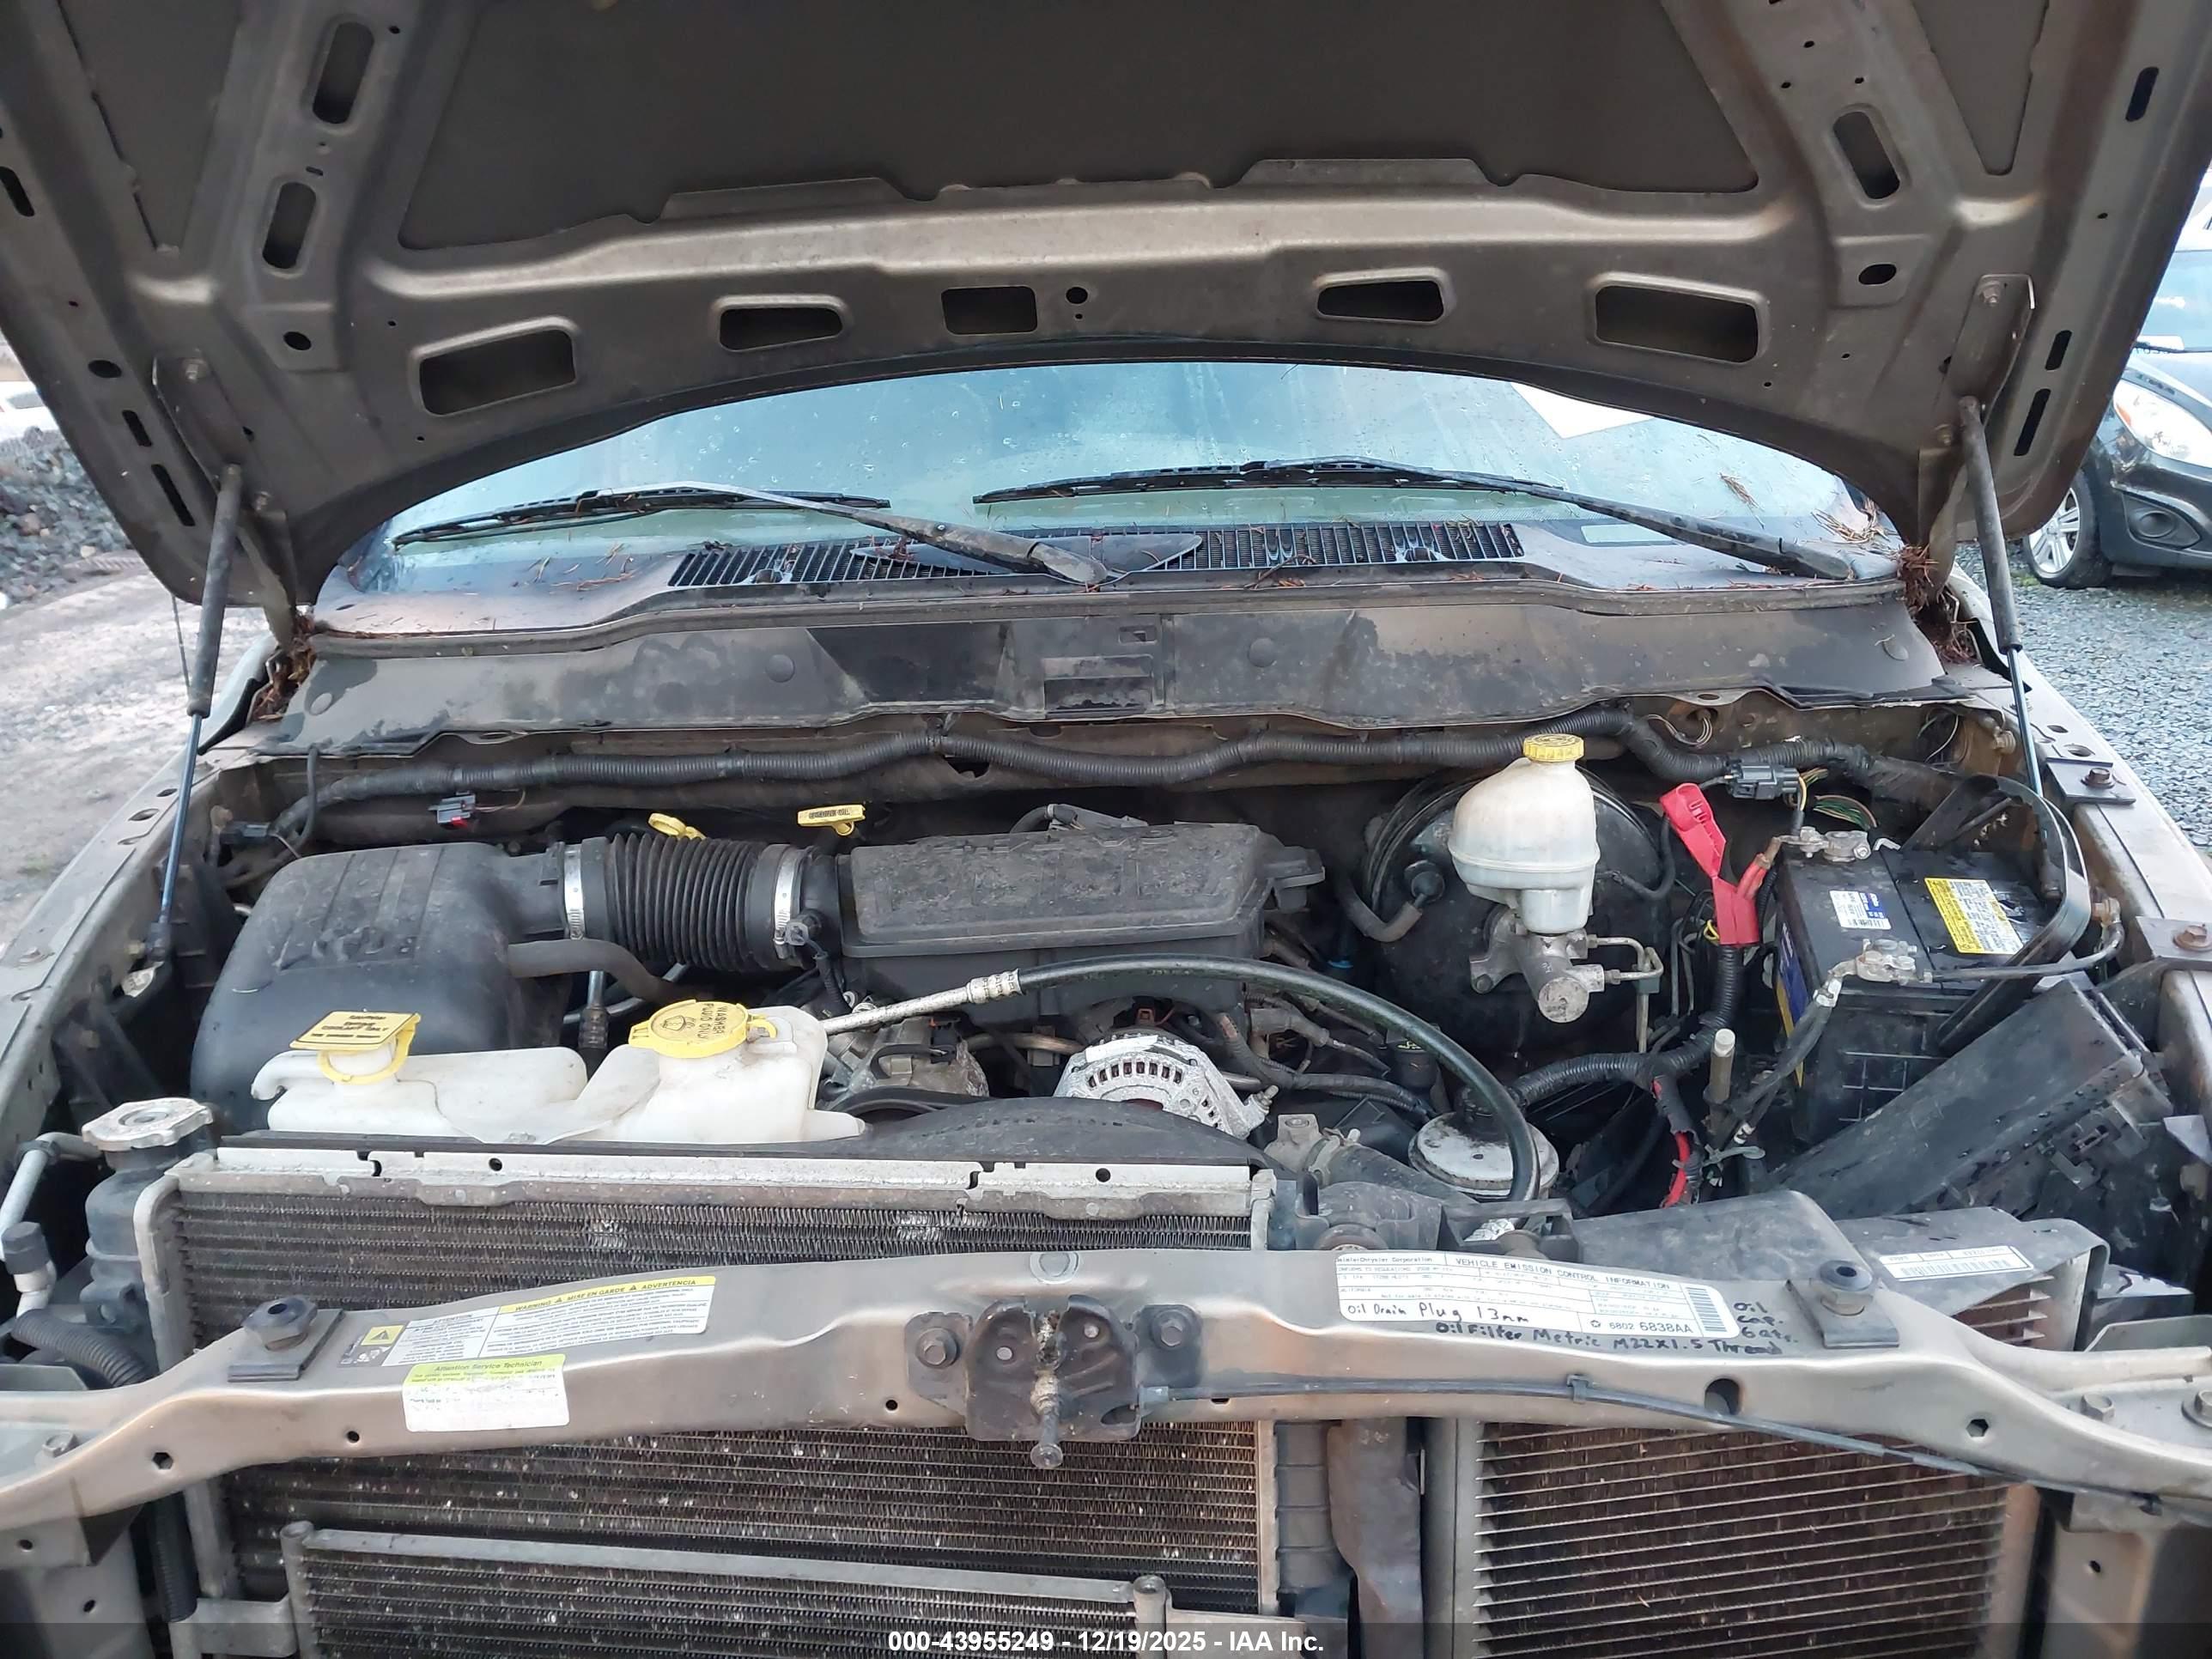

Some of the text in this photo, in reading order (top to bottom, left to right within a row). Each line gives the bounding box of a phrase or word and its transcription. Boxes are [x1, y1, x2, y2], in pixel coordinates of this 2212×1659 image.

[1455, 1257, 1498, 1268] VEHICLE
[1503, 1262, 1553, 1275] EMISSION
[1557, 1269, 1599, 1283] CONTROL
[1605, 1276, 1670, 1290] INFORMATION
[515, 1300, 551, 1311] WARNING
[567, 1292, 586, 1301] MISE
[599, 1286, 625, 1295] GARDE
[641, 1279, 696, 1290] ADVERTENCIA
[1347, 1303, 1366, 1315] Oil
[1373, 1304, 1407, 1316] Drain
[1419, 1302, 1462, 1322] Plug
[1733, 1301, 1769, 1314] Oil
[1608, 1321, 1693, 1334] 6802 6838AA
[1533, 1328, 1601, 1347] Metric
[1708, 1338, 1784, 1355] Thread
[434, 1359, 543, 1373] Attention Service Technician
